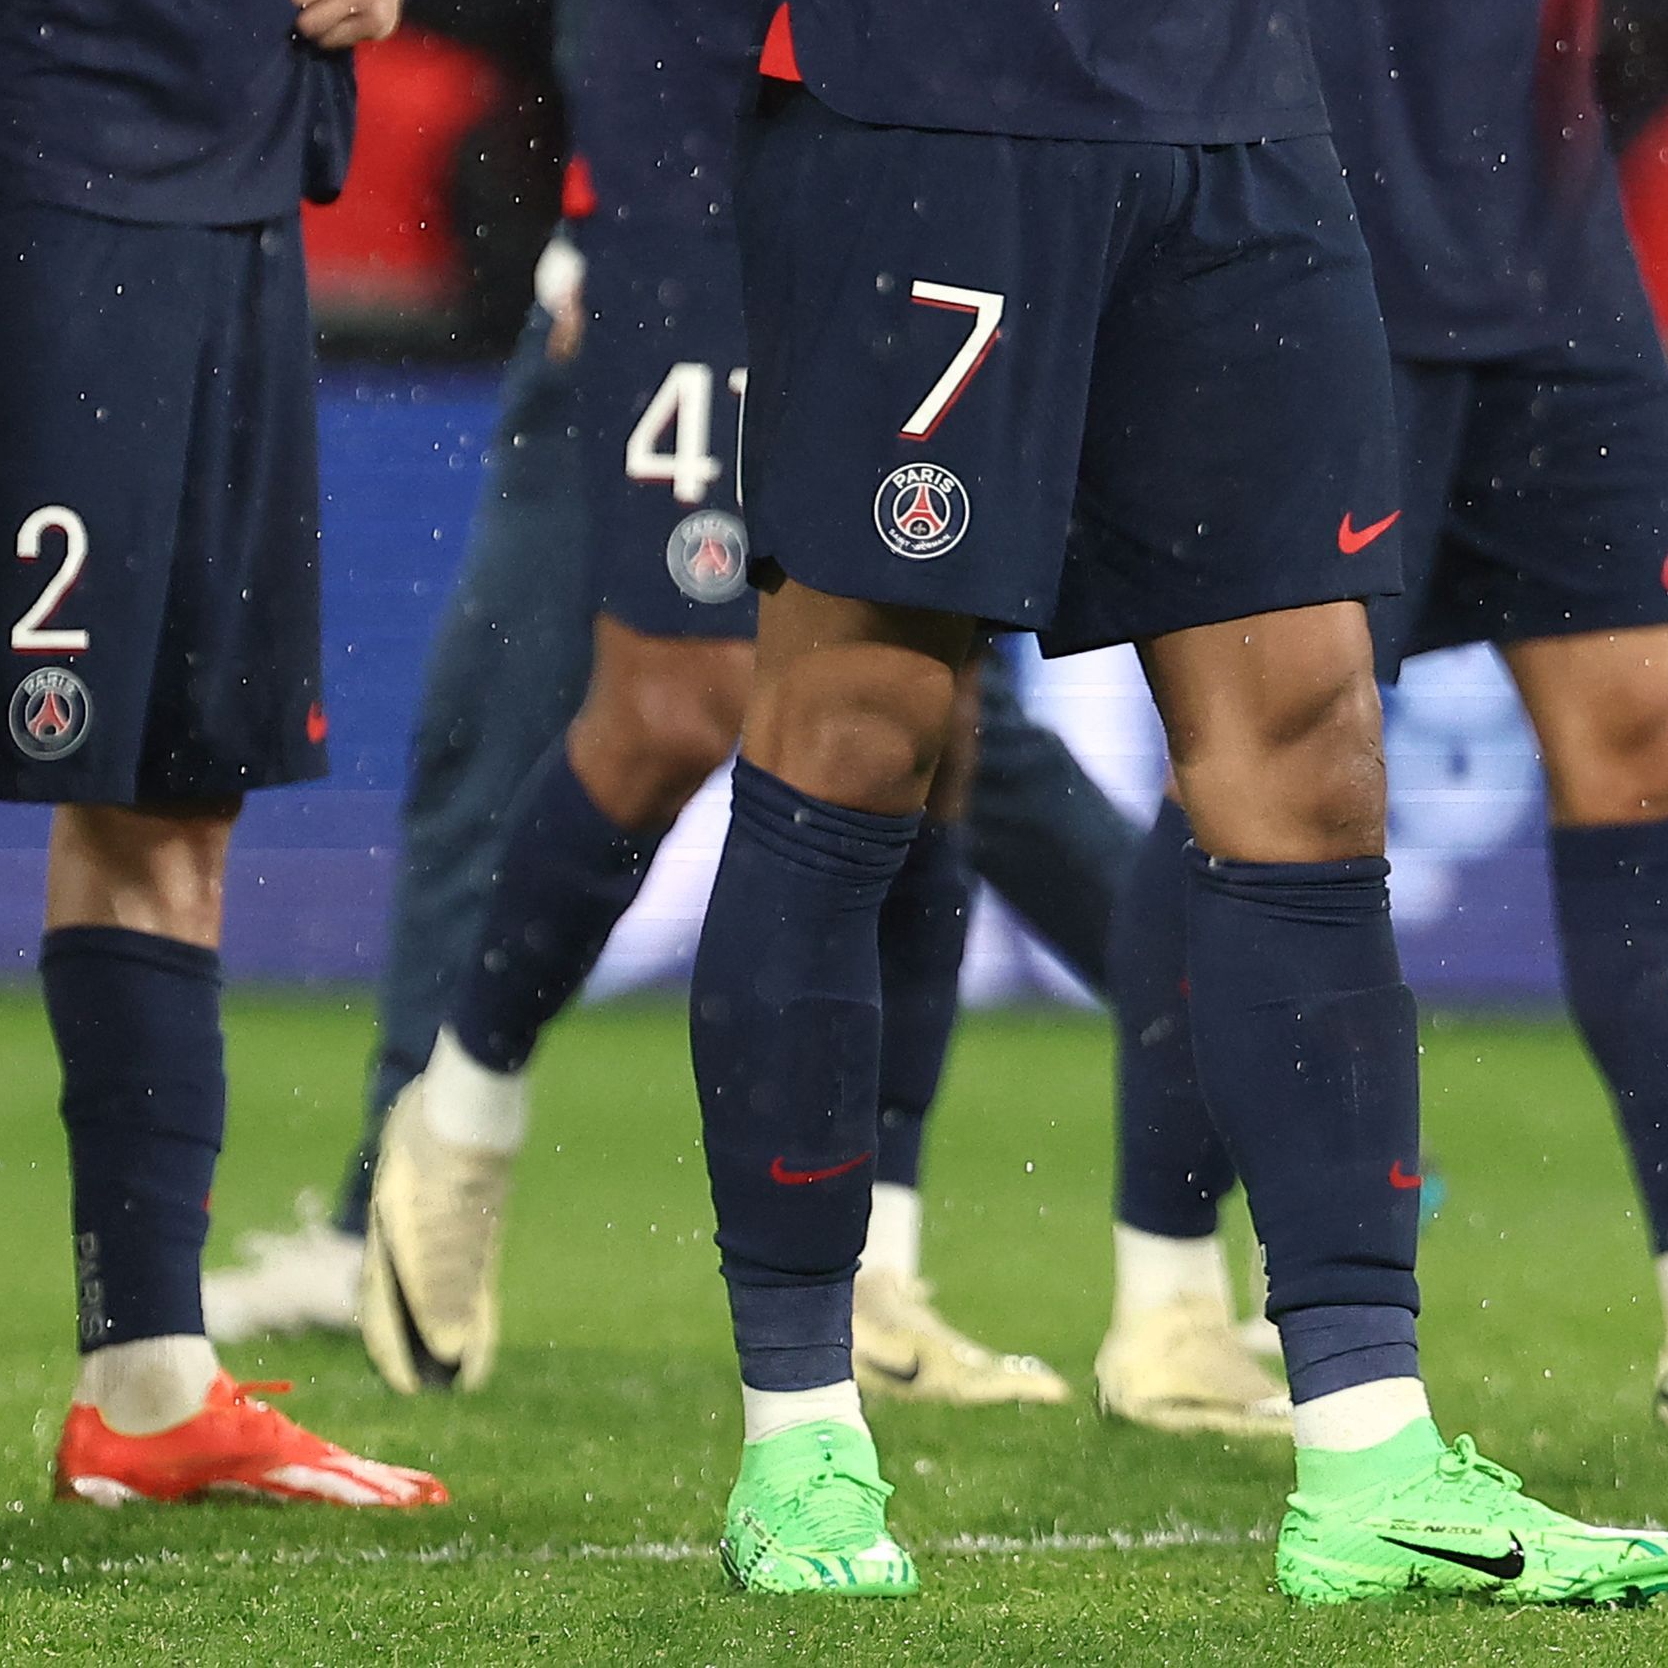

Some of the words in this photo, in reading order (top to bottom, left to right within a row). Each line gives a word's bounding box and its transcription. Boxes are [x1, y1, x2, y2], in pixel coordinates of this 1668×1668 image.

[898, 279, 1005, 441] 7
[892, 468, 956, 494] PARIS
[11, 504, 90, 654] 2
